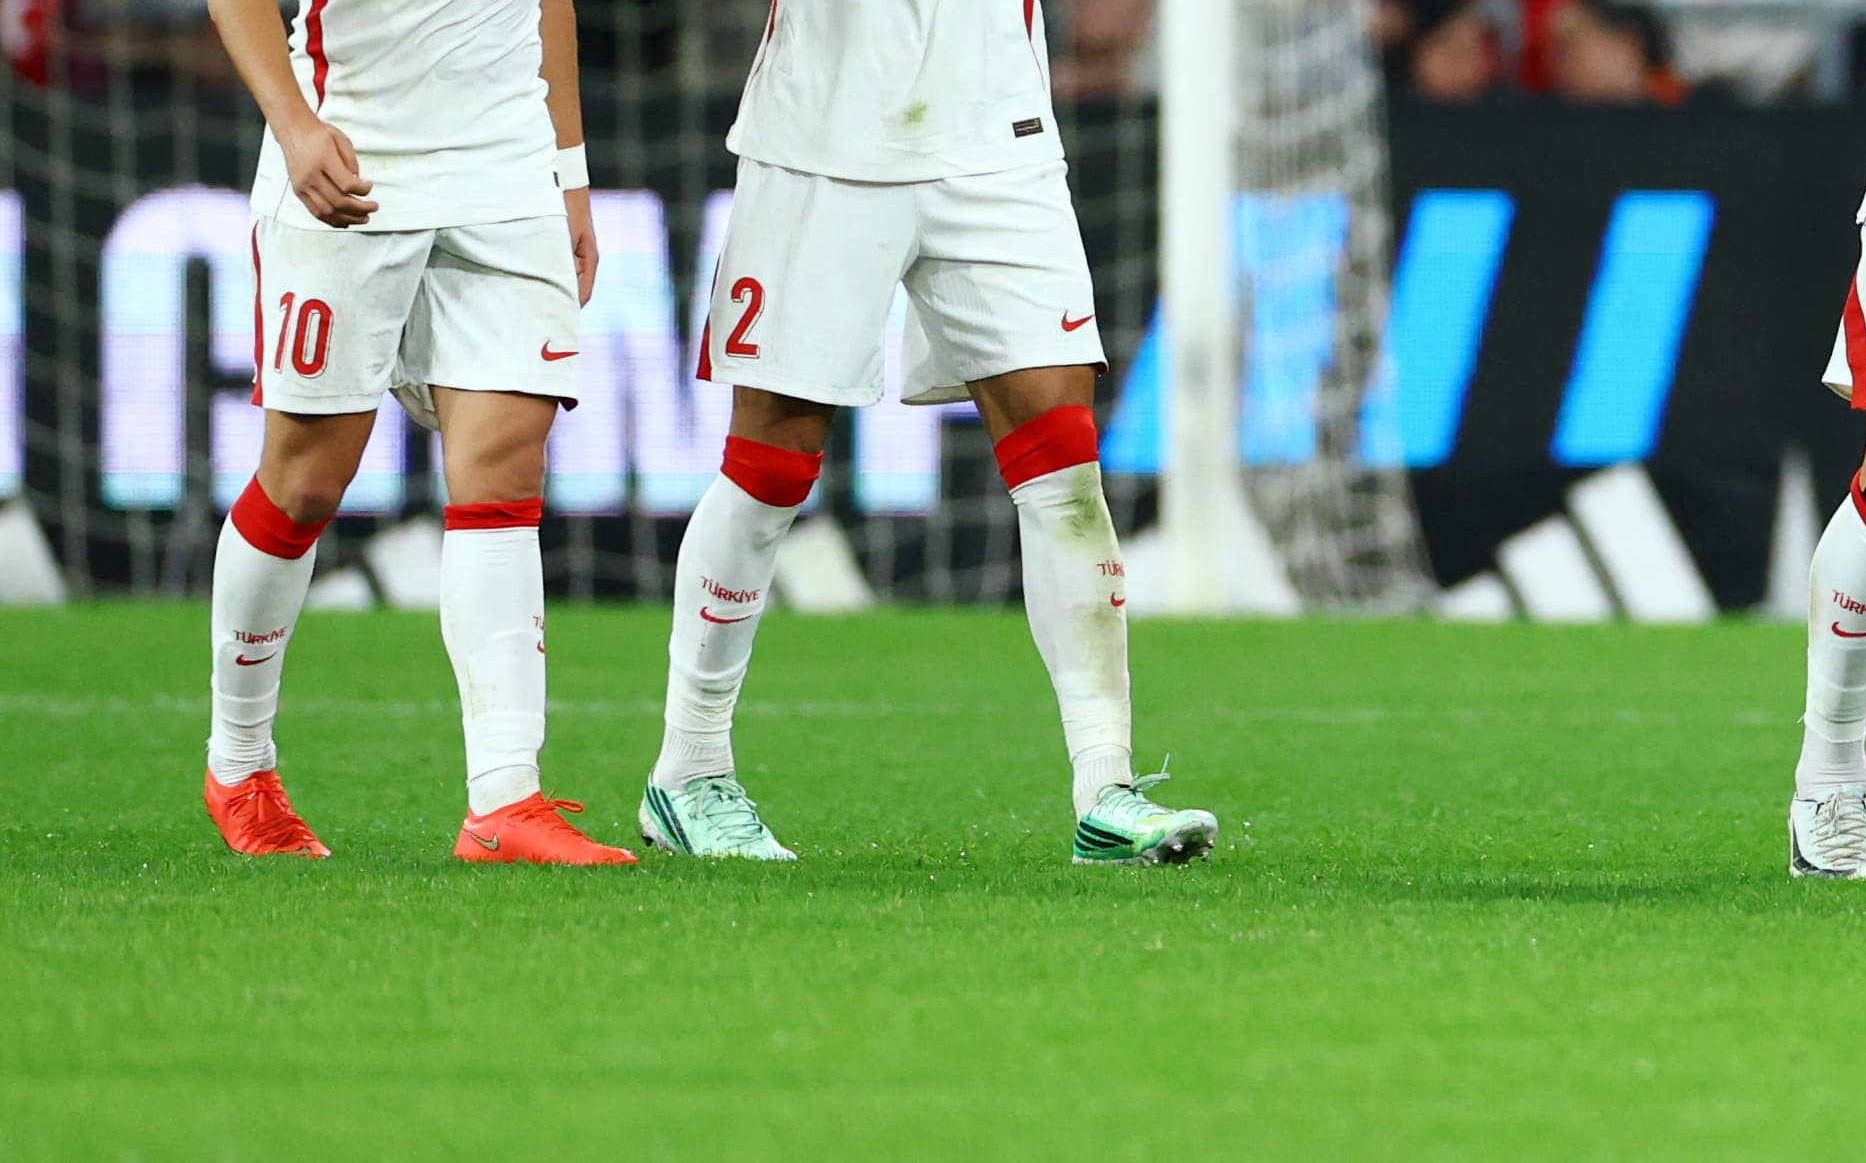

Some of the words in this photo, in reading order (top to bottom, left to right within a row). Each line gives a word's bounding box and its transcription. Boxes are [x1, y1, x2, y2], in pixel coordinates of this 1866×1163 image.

[274, 291, 334, 379] 10
[725, 277, 765, 359] 2
[701, 575, 761, 603] TÜRKİYE
